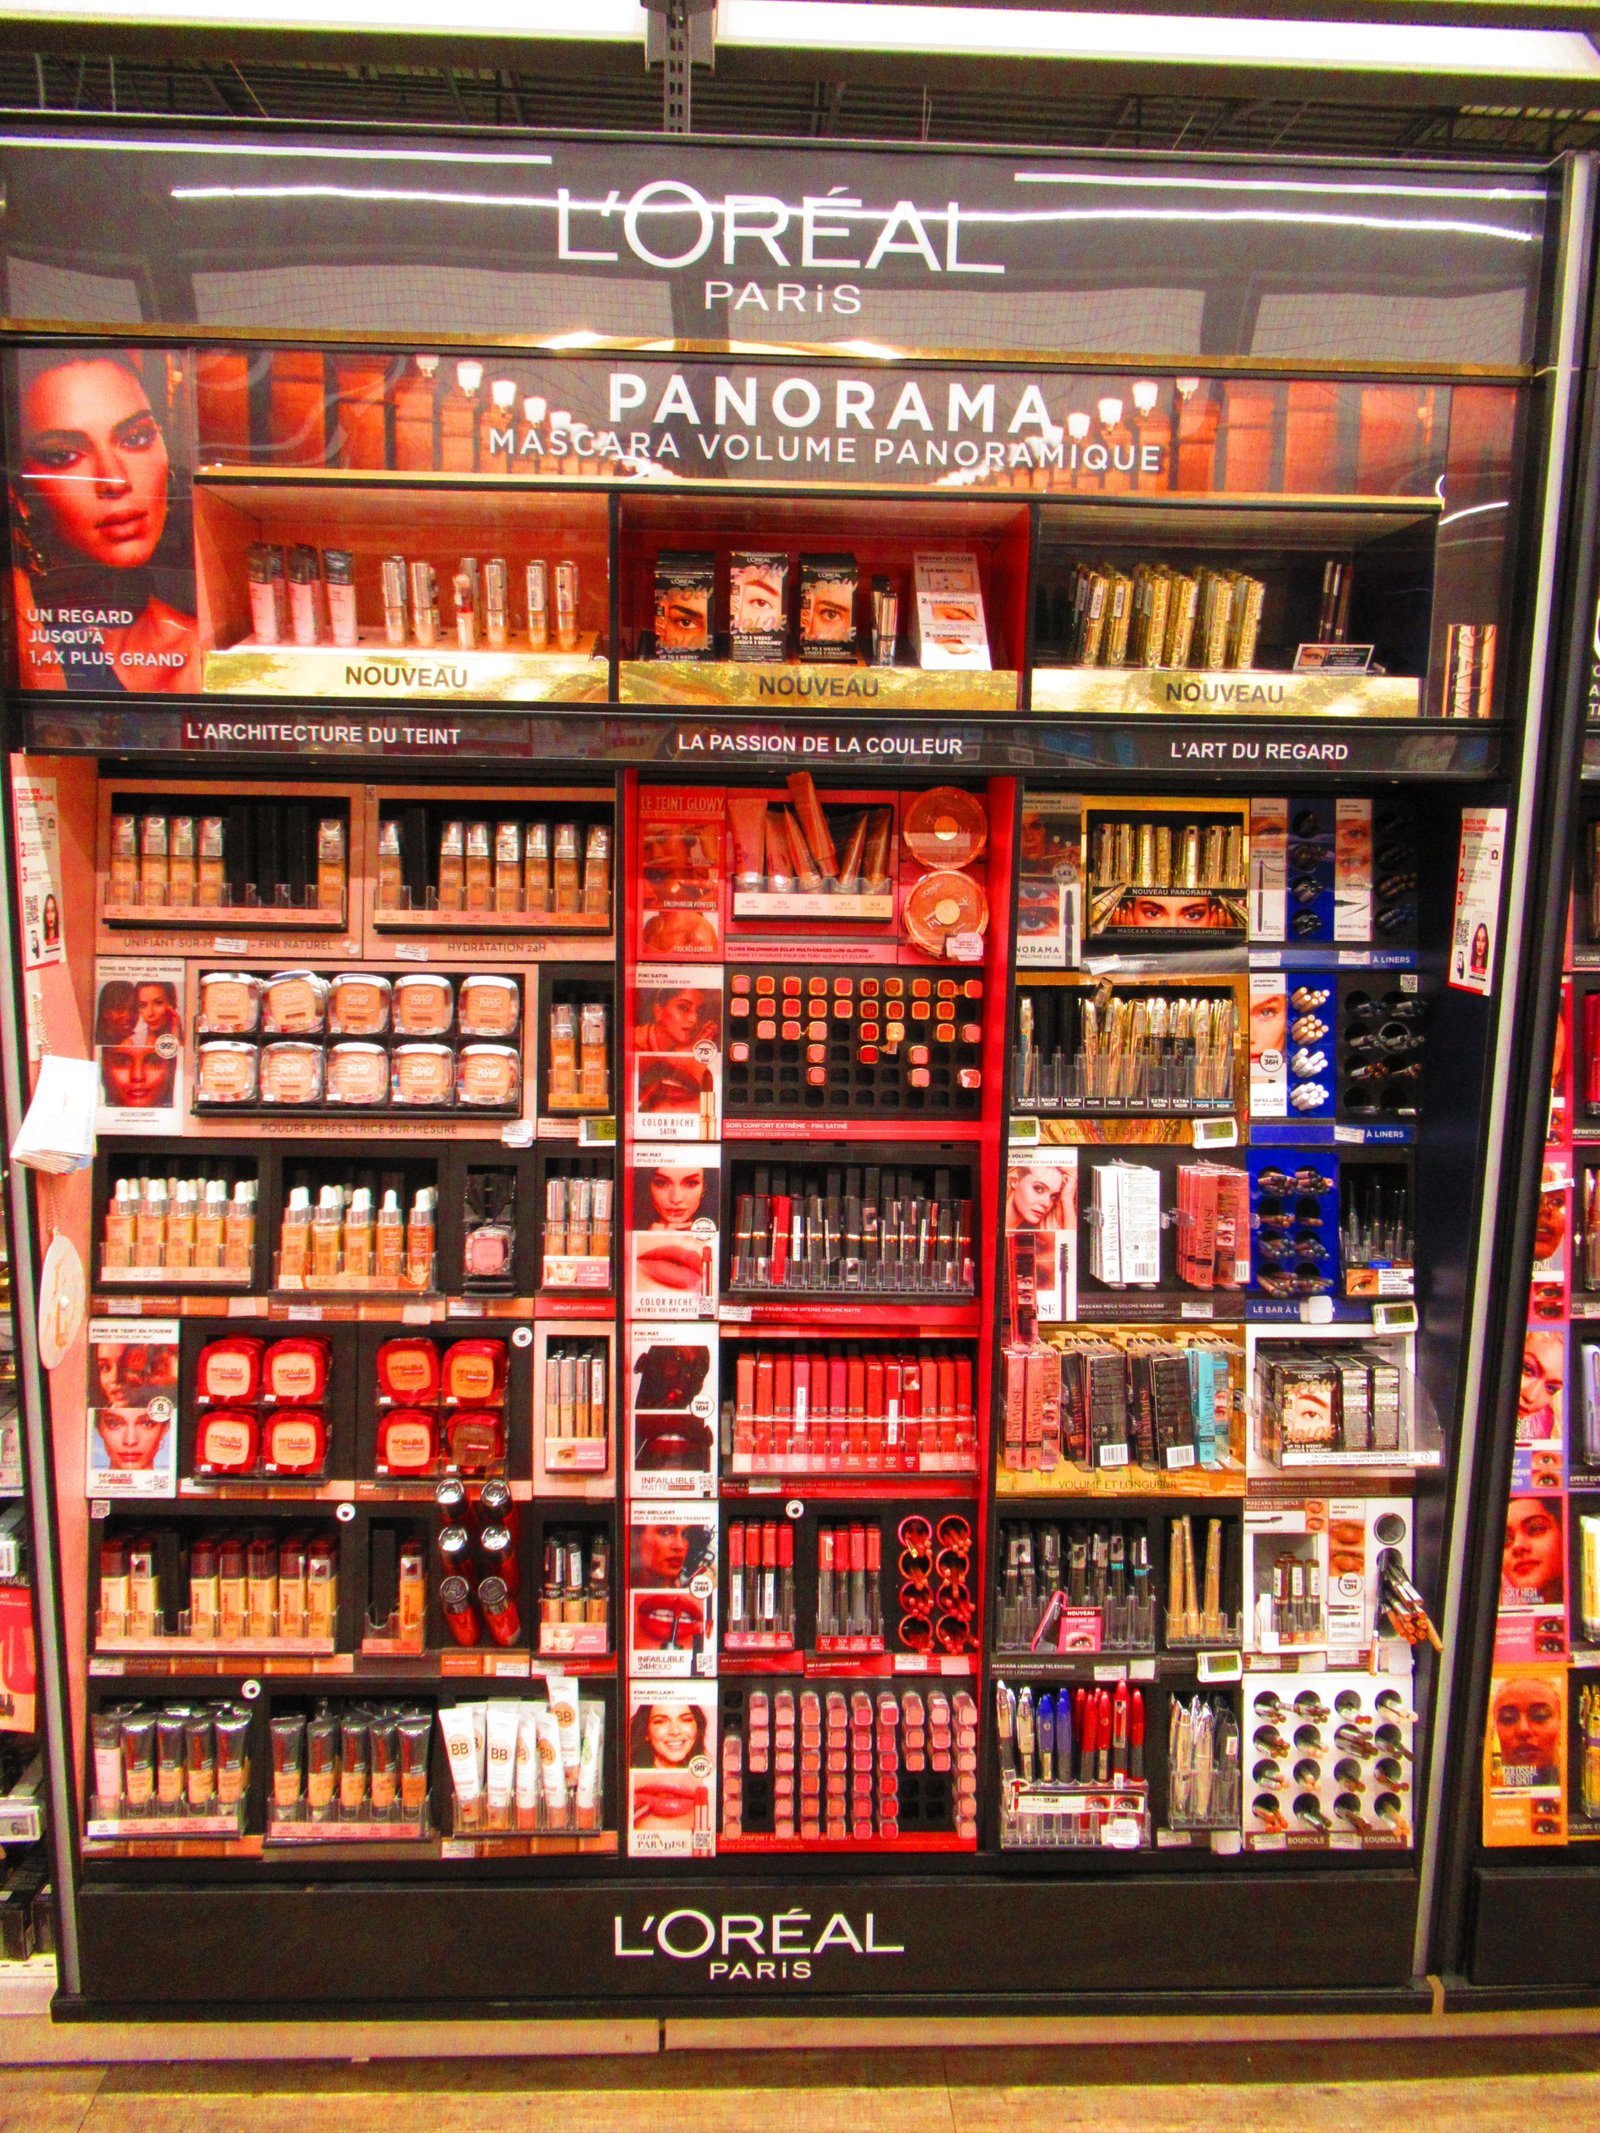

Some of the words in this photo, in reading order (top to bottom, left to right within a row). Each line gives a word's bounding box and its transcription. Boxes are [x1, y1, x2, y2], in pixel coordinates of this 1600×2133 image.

[557, 180, 1005, 274] L'ORÉAL
[609, 373, 1054, 434] PANORAMA
[489, 427, 681, 460] MASCARA
[698, 433, 856, 465] VOLUME
[875, 437, 1161, 473] PANORAMIQUE
[27, 609, 53, 623] UN
[58, 609, 133, 624] REGARD
[29, 627, 105, 645] JUSQU'À
[30, 651, 65, 666] 1,4X
[71, 651, 115, 666] PLUS
[345, 665, 469, 689] NOUVEAU
[758, 676, 879, 698] NOUVEAU
[1166, 682, 1285, 704] NOUVEAU
[187, 721, 363, 743] L'ARCHITECTURE
[368, 726, 397, 744] DU
[402, 726, 461, 745] TEINT
[678, 733, 705, 751] LA
[709, 734, 799, 752] PASSION
[803, 736, 830, 753] DE
[835, 736, 861, 753] LA
[866, 737, 963, 756] COULEUR
[1171, 741, 1227, 760] L'ART
[1232, 743, 1261, 760] DU
[1265, 743, 1349, 761] REGARD
[656, 796, 684, 811] TEINT
[687, 797, 724, 812] GLOWY
[20, 842, 27, 857] 2
[1461, 844, 1466, 859] 1
[22, 867, 28, 883] 3
[1459, 868, 1465, 883] 2
[1132, 888, 1169, 896] NOUVEAU
[1170, 889, 1213, 897] PANORAMA
[1458, 891, 1463, 906] 3
[124, 938, 175, 948] UNIFIANT
[259, 940, 281, 950] FINI
[284, 941, 333, 951] NATUREL
[448, 942, 524, 952] HYDRATATION
[527, 944, 547, 952] 24H
[1372, 955, 1381, 964] À
[1383, 956, 1411, 964] LINERS
[1263, 1058, 1279, 1066] 36H
[261, 1123, 306, 1133] POUDRE
[310, 1123, 384, 1134] PERFECTRICE
[388, 1124, 458, 1135] SUR-MESURE
[642, 1118, 668, 1127] COLOR
[670, 1119, 695, 1128] RICHE
[776, 1121, 806, 1129] EXTRÊME
[659, 1127, 677, 1135] SATIN
[1062, 1126, 1106, 1135] VOLUME
[1107, 1126, 1118, 1135] ET
[1366, 1129, 1373, 1138] À
[1374, 1130, 1404, 1138] LINERS
[640, 1298, 666, 1306] COLOR
[669, 1298, 693, 1306] RICHE
[1252, 1305, 1264, 1313] LE
[1265, 1306, 1283, 1314] BAR
[1285, 1304, 1293, 1314] À
[695, 1404, 710, 1412] 16H
[641, 1476, 695, 1485] INFAILLIBLE
[1058, 1480, 1102, 1489] VOLUME
[1104, 1480, 1117, 1489] ET
[1119, 1480, 1178, 1489] LONGUEUR
[1505, 1587, 1520, 1598] SKY
[1521, 1587, 1538, 1598] HIGH
[555, 1710, 572, 1723] BB
[450, 1742, 469, 1756] BB
[491, 1748, 508, 1761] BB
[1503, 1765, 1538, 1776] COLOSSAL
[1503, 1776, 1515, 1786] BIG
[1516, 1776, 1533, 1786] SHOT
[637, 1833, 660, 1842] GLOW
[1287, 1837, 1325, 1845] SOURCILS
[1363, 1836, 1402, 1844] SOURCILS
[637, 1840, 688, 1850] PARADISE
[614, 1907, 905, 1959] L'ORÉAL
